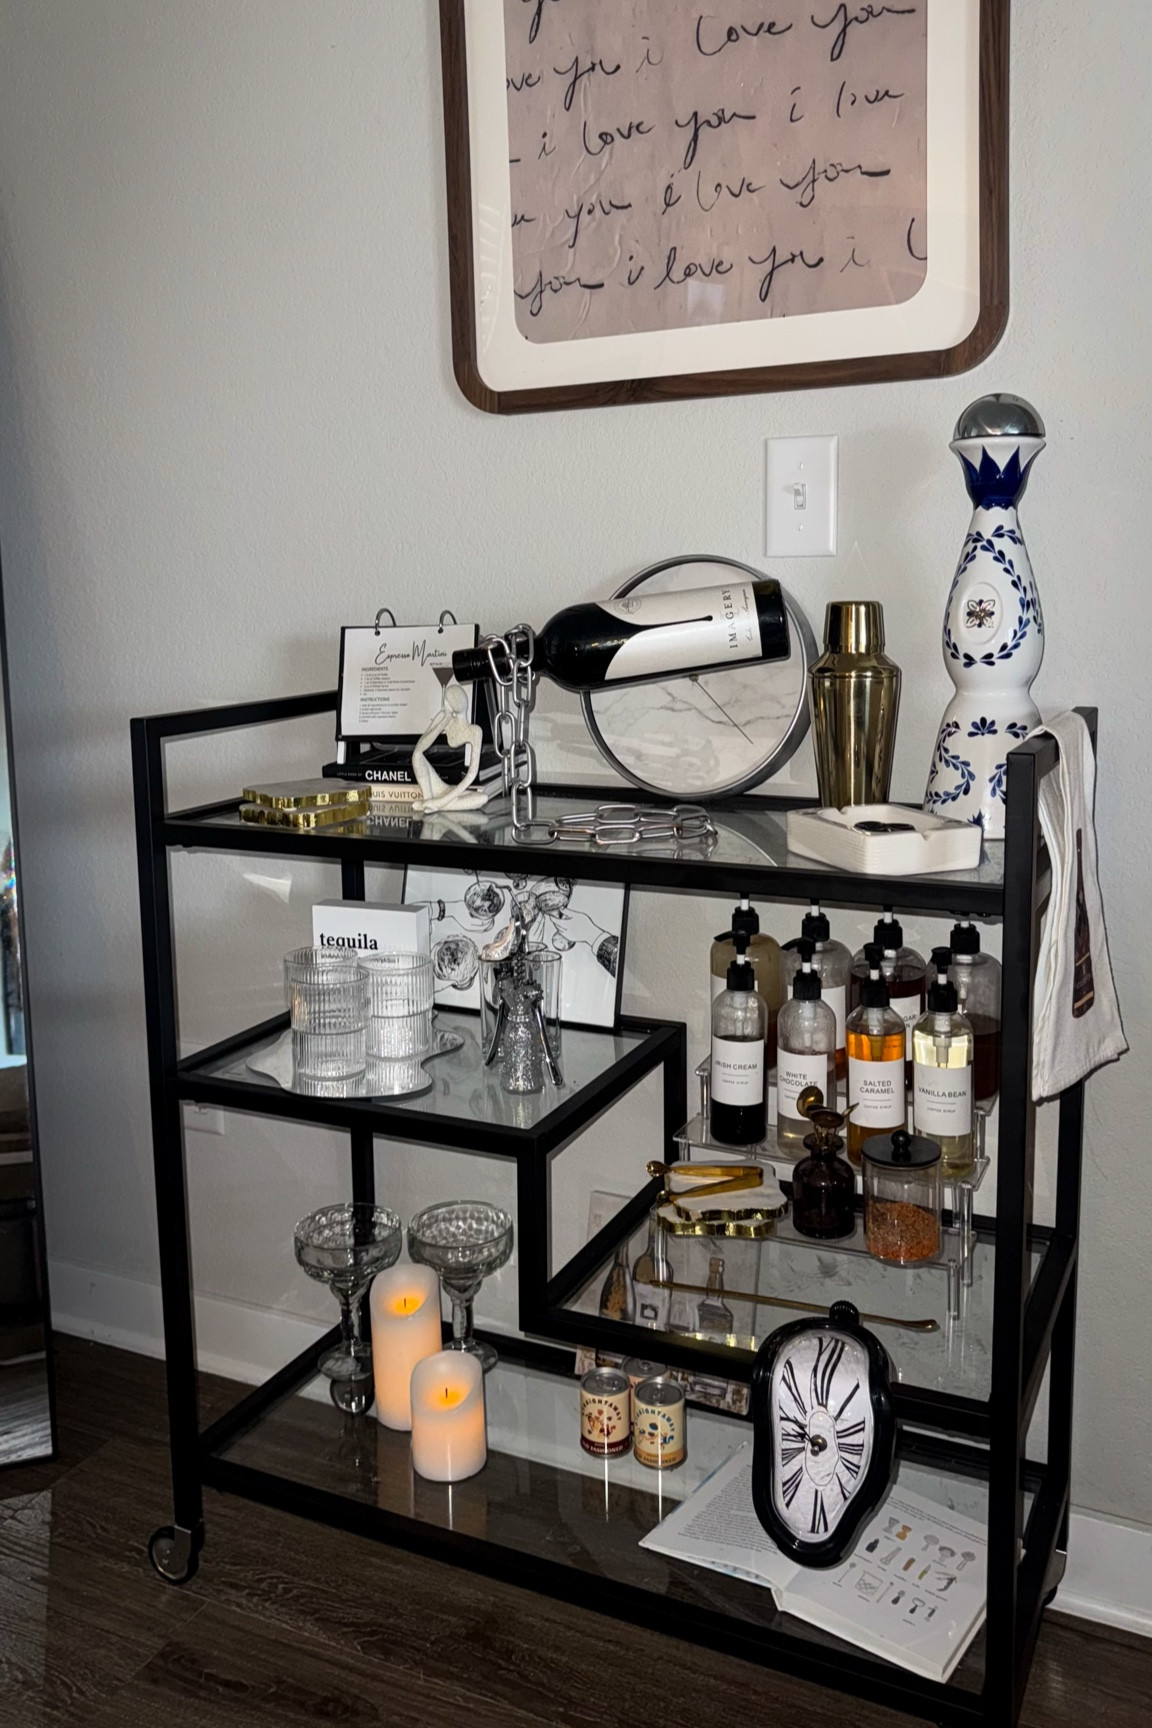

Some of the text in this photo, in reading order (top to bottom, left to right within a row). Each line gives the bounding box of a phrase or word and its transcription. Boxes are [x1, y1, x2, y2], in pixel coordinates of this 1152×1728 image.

[553, 56, 621, 112] you
[696, 15, 793, 56] love
[811, 3, 916, 61] you
[583, 119, 655, 156] love
[675, 108, 757, 169] you
[565, 199, 632, 249] you
[697, 170, 766, 212] love
[779, 158, 891, 208] you
[513, 270, 604, 316] you
[654, 246, 733, 290] love
[748, 245, 824, 302] you
[721, 588, 739, 649] IMAGERY
[365, 770, 412, 782] CHANEL
[319, 932, 379, 951] tequila
[733, 1063, 758, 1071] CREAM
[785, 1070, 808, 1081] WHITE
[863, 1079, 892, 1087] SALTED
[918, 1086, 967, 1098] VANILLA BEAN
